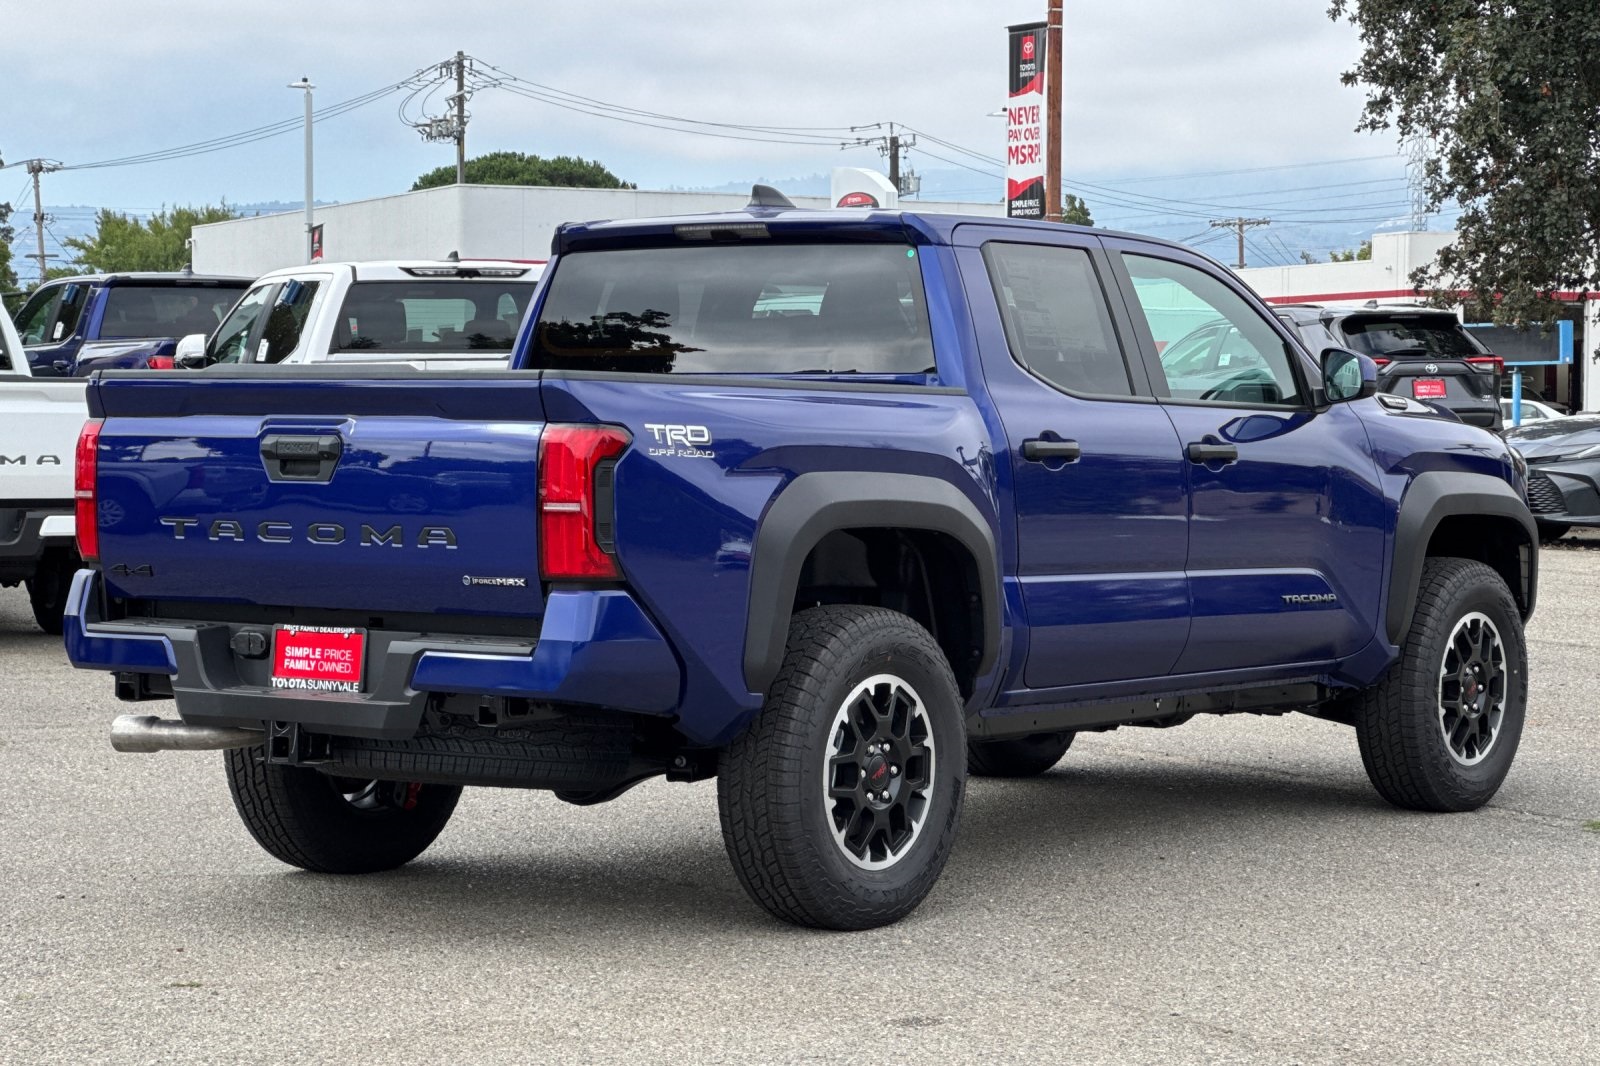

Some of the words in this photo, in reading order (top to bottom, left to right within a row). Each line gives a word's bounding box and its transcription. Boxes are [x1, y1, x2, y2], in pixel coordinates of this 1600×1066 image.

[1008, 105, 1040, 126] NEVER
[1008, 128, 1022, 142] PAY
[1024, 127, 1040, 141] OVER
[1008, 143, 1041, 165] MSRP!
[644, 423, 712, 447] TRD
[279, 442, 317, 453] TOYOTA
[678, 450, 715, 458] ROAD
[159, 517, 458, 549] TACOMA
[1281, 593, 1337, 604] TACOMA
[285, 646, 322, 659] SIMPLE
[324, 649, 354, 662] PRICE.
[284, 659, 316, 671] FAMILY
[317, 661, 353, 674] OWNED.
[271, 678, 307, 689] TOYOTA
